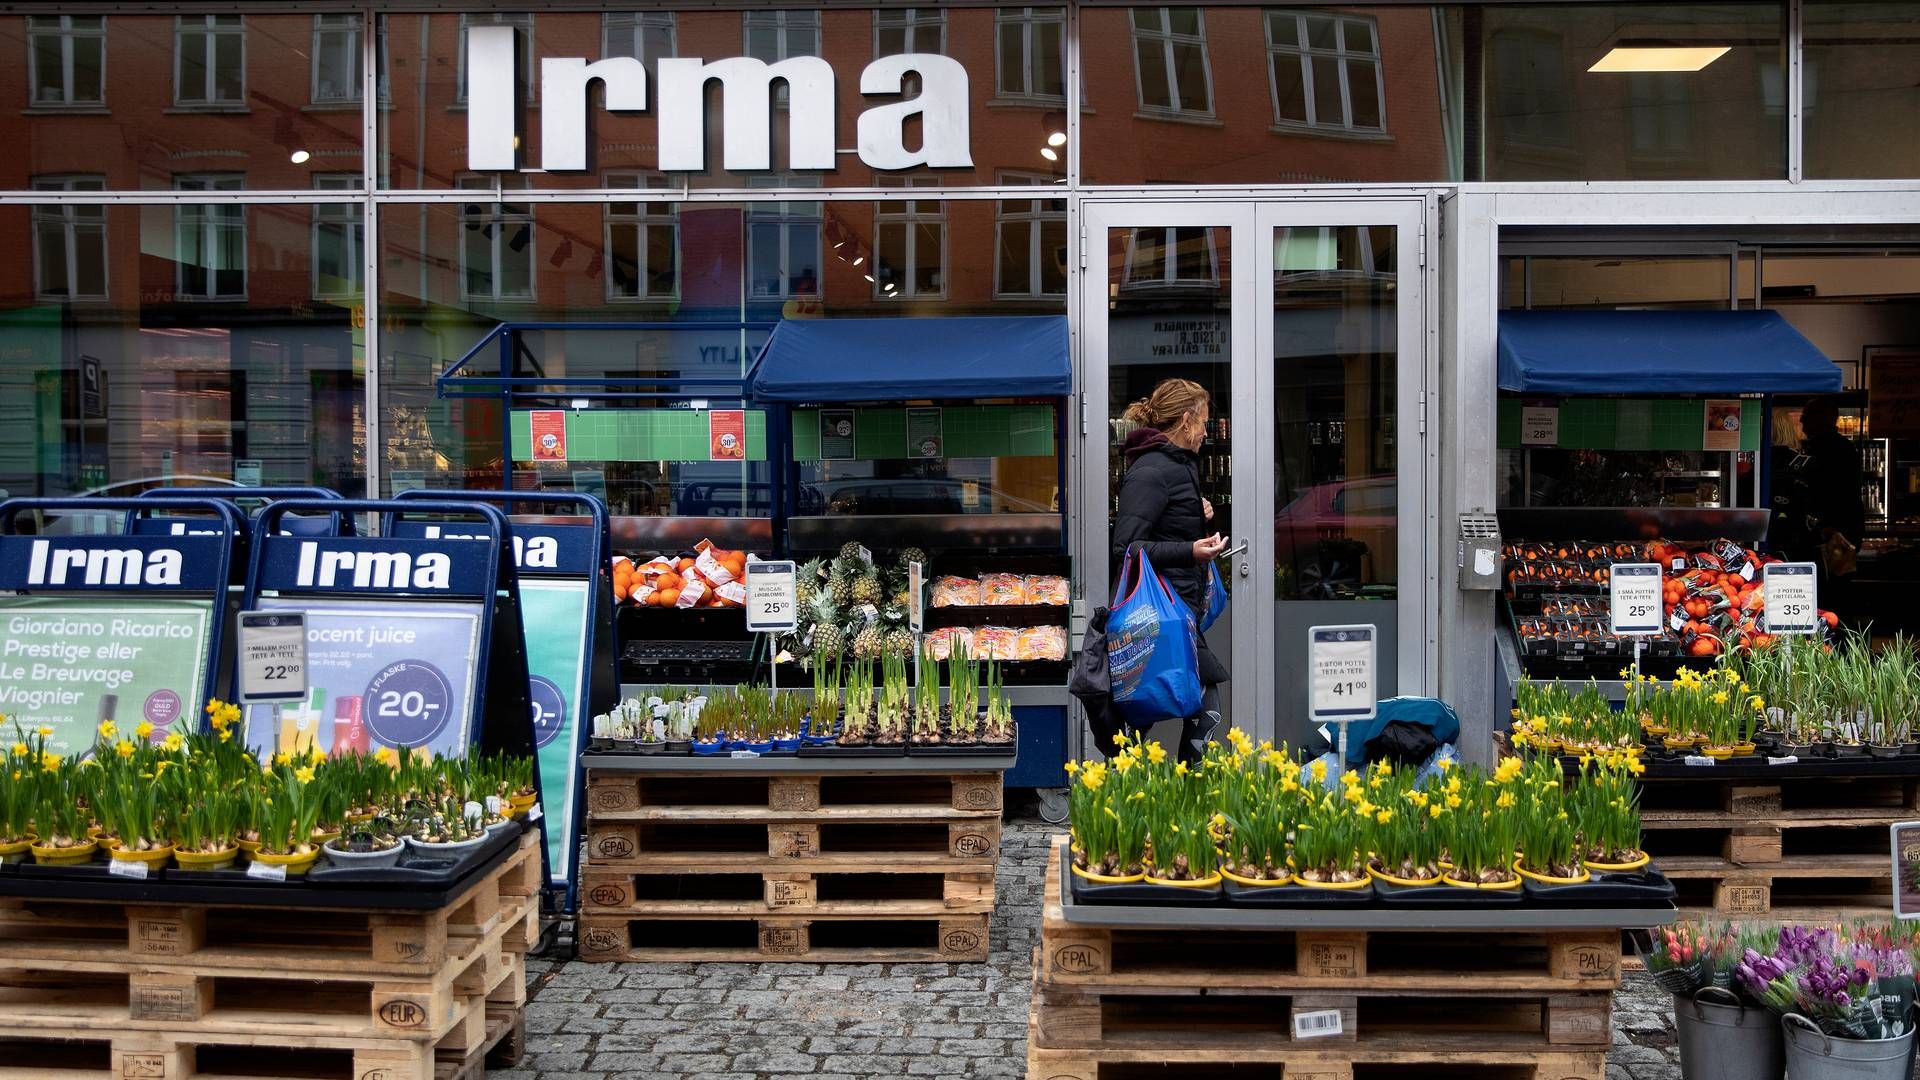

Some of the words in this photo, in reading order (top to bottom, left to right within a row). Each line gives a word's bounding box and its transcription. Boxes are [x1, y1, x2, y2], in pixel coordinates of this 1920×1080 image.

[468, 26, 975, 172] Irma
[27, 540, 183, 585] Irma
[297, 541, 451, 589] Irma
[9, 617, 104, 636] Giordano
[110, 619, 193, 638] Ricarico
[307, 627, 364, 643] ocent
[366, 625, 417, 648] juice
[4, 640, 92, 664] Prestige
[96, 642, 143, 660] eller
[1324, 660, 1342, 668] STOR
[1344, 659, 1366, 667] POTTE
[1, 662, 25, 680] Le
[31, 663, 134, 689] Breuvage
[375, 663, 406, 688] FLASKE
[0, 686, 84, 710] Viognier
[378, 690, 440, 720] 20,-
[969, 791, 989, 802] EPAL
[604, 841, 628, 853] EPAL
[960, 838, 985, 851] EPAL
[596, 889, 620, 902] EPAL
[949, 935, 974, 947] EPAL
[390, 1004, 416, 1023] EUR
